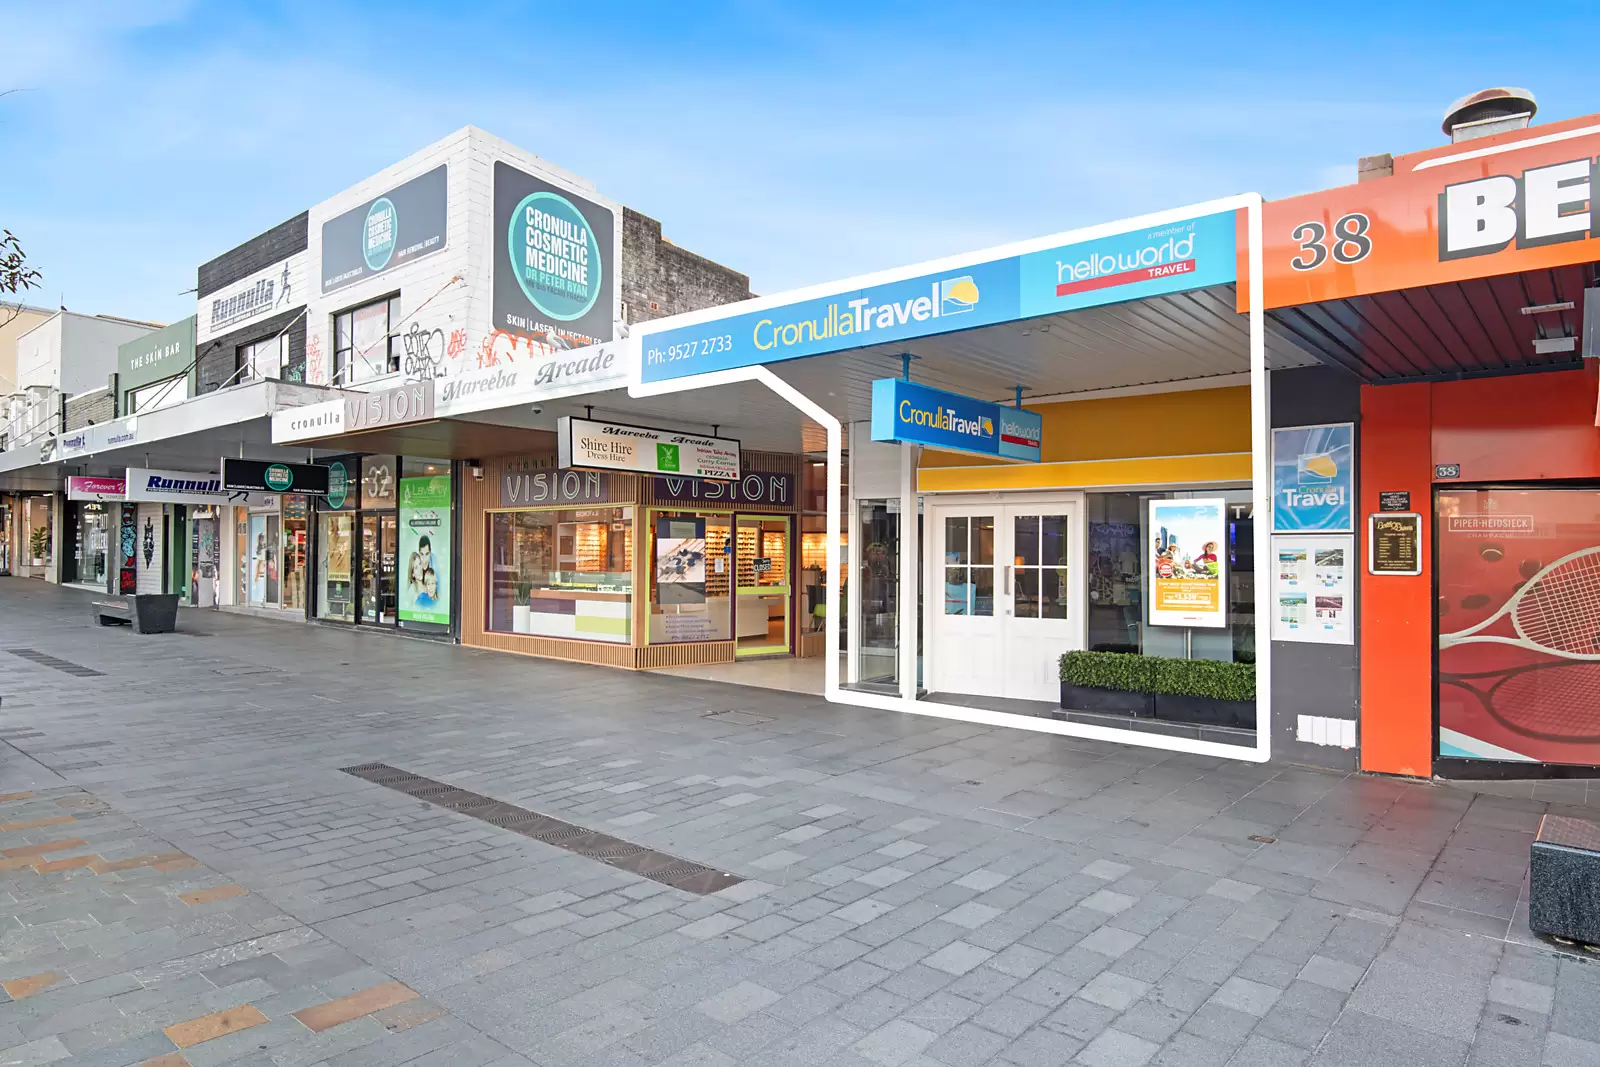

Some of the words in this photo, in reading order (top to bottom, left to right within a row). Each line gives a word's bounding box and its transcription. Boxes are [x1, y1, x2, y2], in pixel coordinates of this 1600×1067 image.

[1438, 156, 1600, 262] BE
[526, 206, 588, 247] CRONULLA
[1153, 225, 1184, 238] member
[1186, 222, 1196, 232] of
[526, 226, 588, 266] COSMETIC
[1290, 212, 1373, 272] 38
[526, 245, 588, 286] MEDICINE
[1148, 262, 1190, 278] TRAVEL
[526, 266, 537, 281] DR
[540, 270, 566, 290] PETER
[567, 280, 588, 297] RYAN
[211, 279, 274, 324] Runnulla
[506, 313, 526, 328] SKIN
[529, 320, 553, 334] LASER
[130, 356, 142, 370] THE
[146, 344, 162, 366] SKIN
[164, 341, 180, 358] BAR
[648, 348, 666, 366] Ph:
[668, 342, 698, 362] 9527
[701, 334, 732, 356] 2733
[442, 368, 518, 402] Mareeba
[534, 348, 615, 386] Arcade
[291, 412, 340, 430] cronulla
[348, 386, 426, 428] VISION
[580, 438, 608, 452] Shire
[610, 441, 633, 455] Hire
[602, 426, 660, 440] Mareeba
[670, 436, 714, 447] Arcade
[587, 450, 608, 461] Dress
[610, 453, 626, 462] Hire
[84, 480, 116, 492] Forever
[147, 476, 222, 492] Runnull
[368, 464, 393, 499] 32
[704, 470, 731, 478] PIZZA
[1439, 466, 1457, 477] 38
[506, 471, 600, 503] VISION
[666, 474, 787, 503] VISION
[1282, 486, 1345, 507] Travel
[1299, 485, 1337, 494] Cronulla
[754, 564, 771, 572] CLOSED
